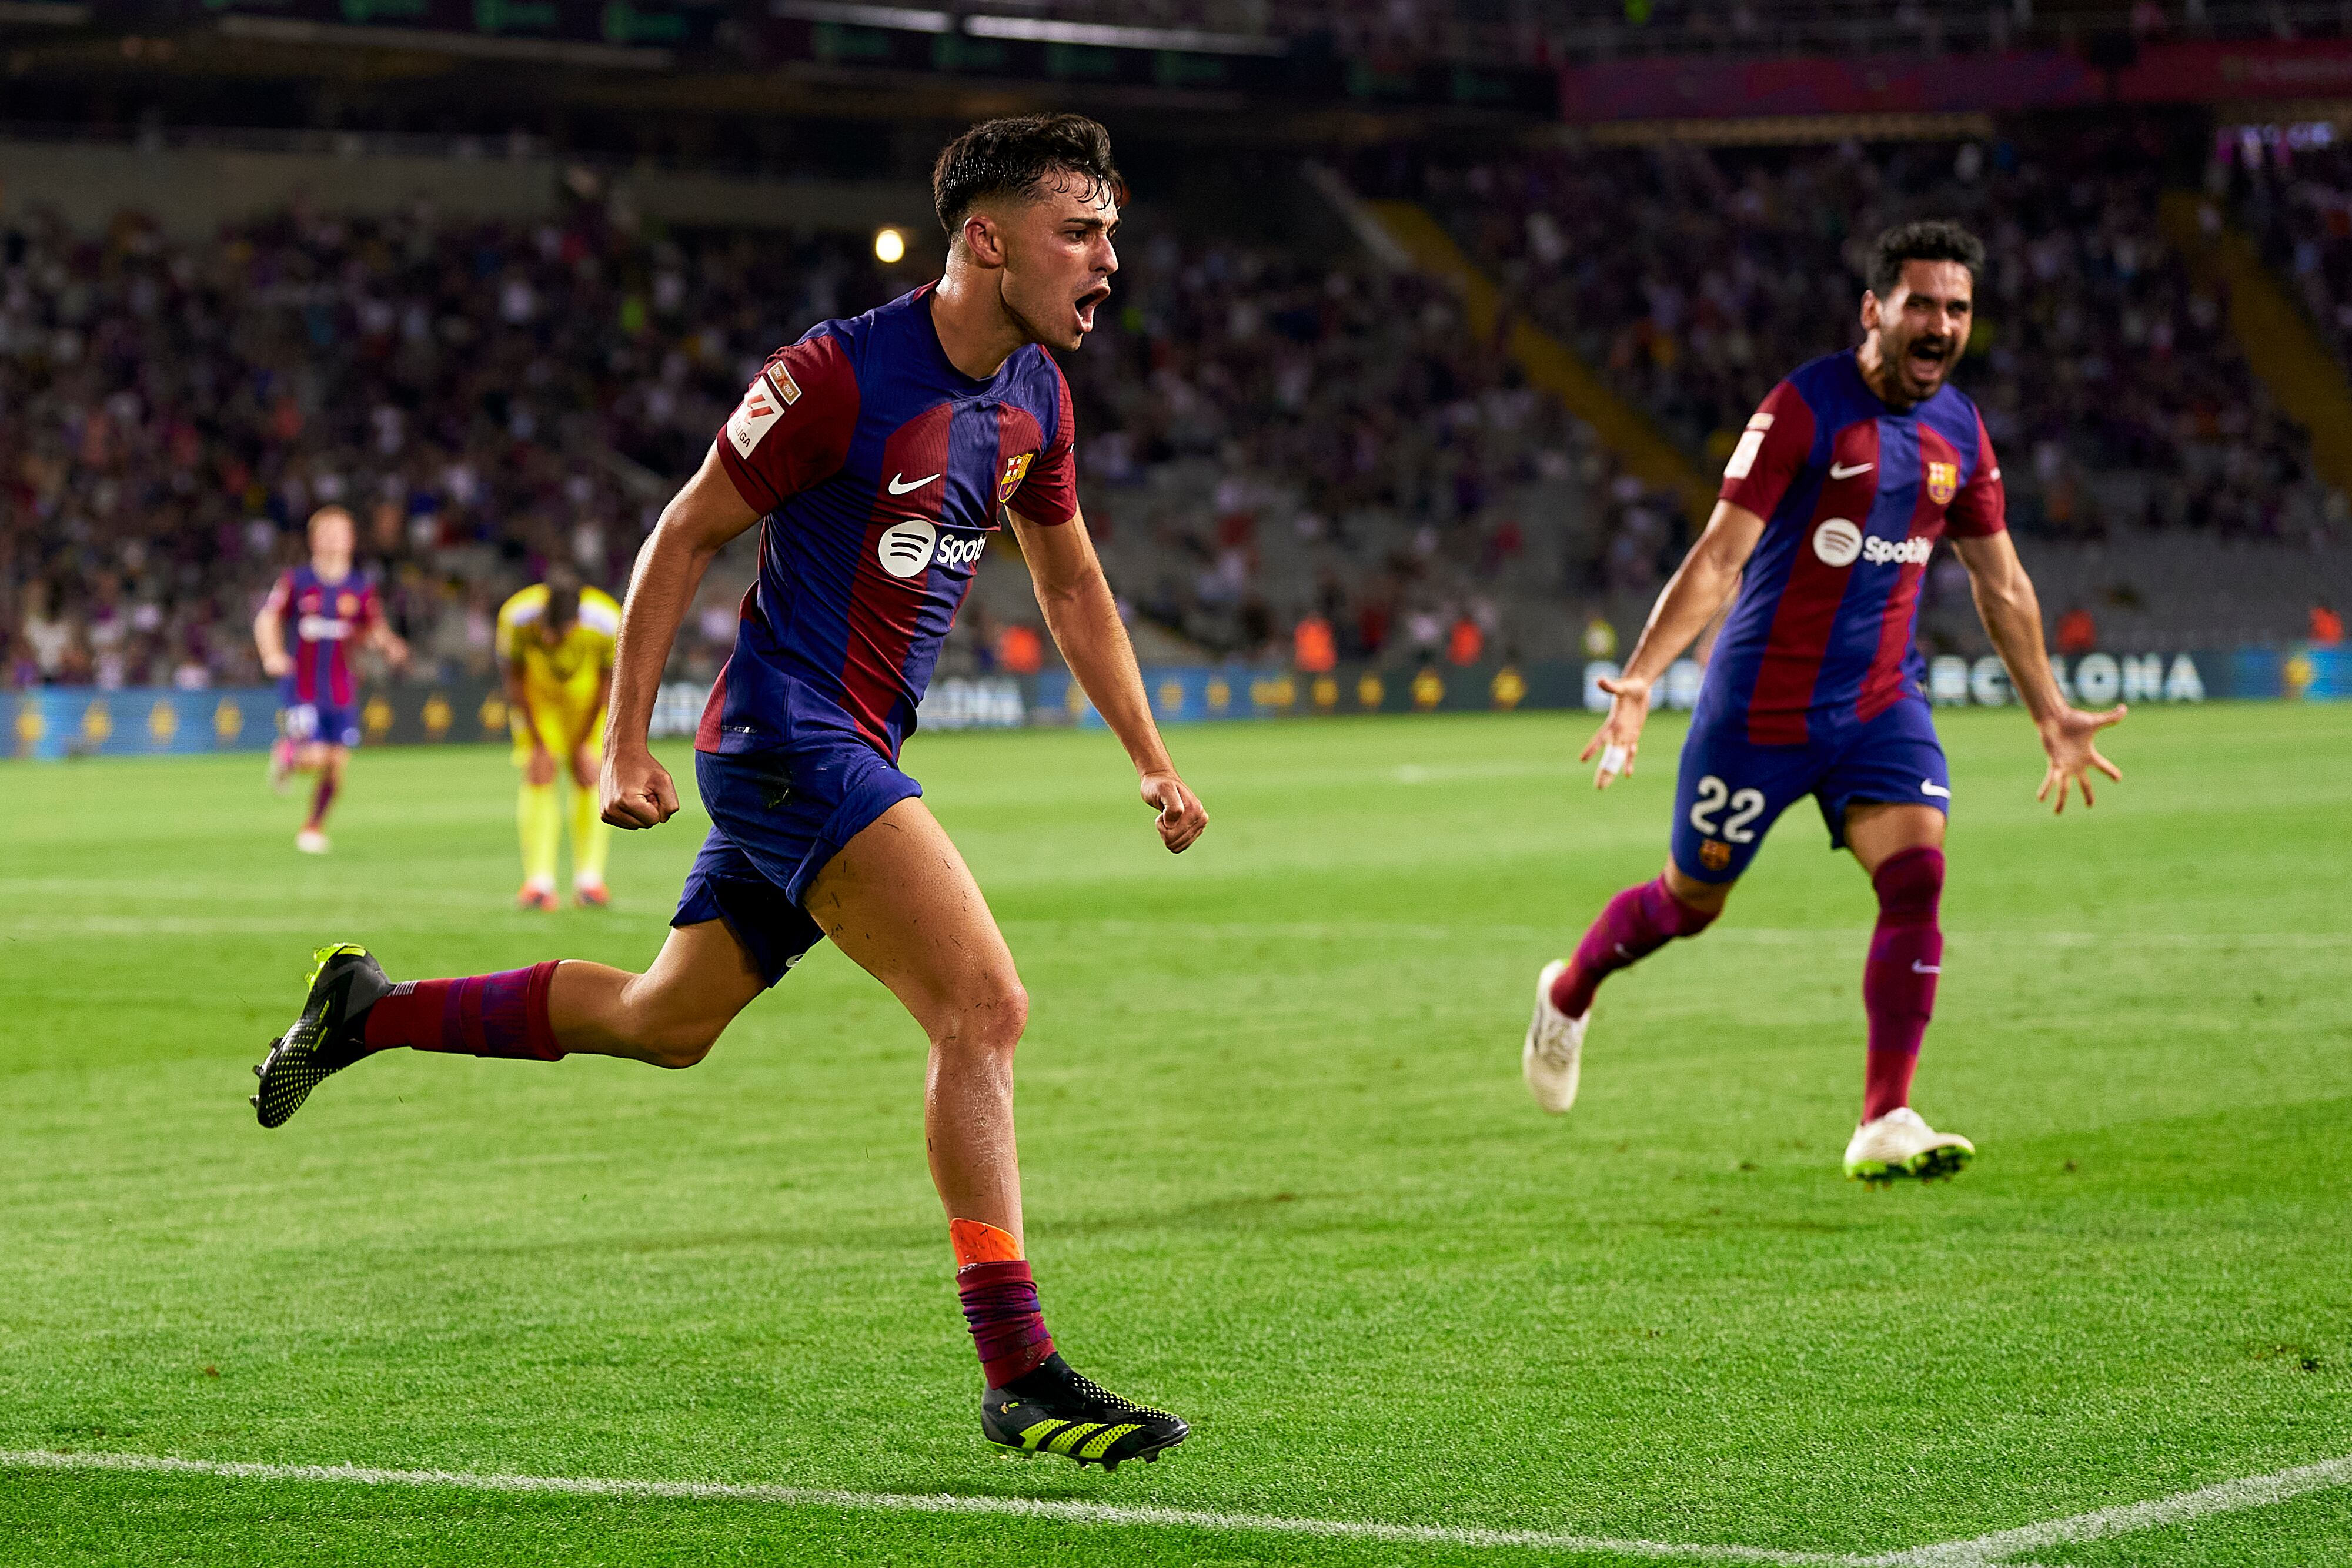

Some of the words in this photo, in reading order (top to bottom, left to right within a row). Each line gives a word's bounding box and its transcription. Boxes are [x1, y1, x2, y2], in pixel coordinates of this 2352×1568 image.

[784, 384, 794, 396] 2023
[734, 417, 751, 447] LALIGA
[1690, 775, 1765, 844] 22
